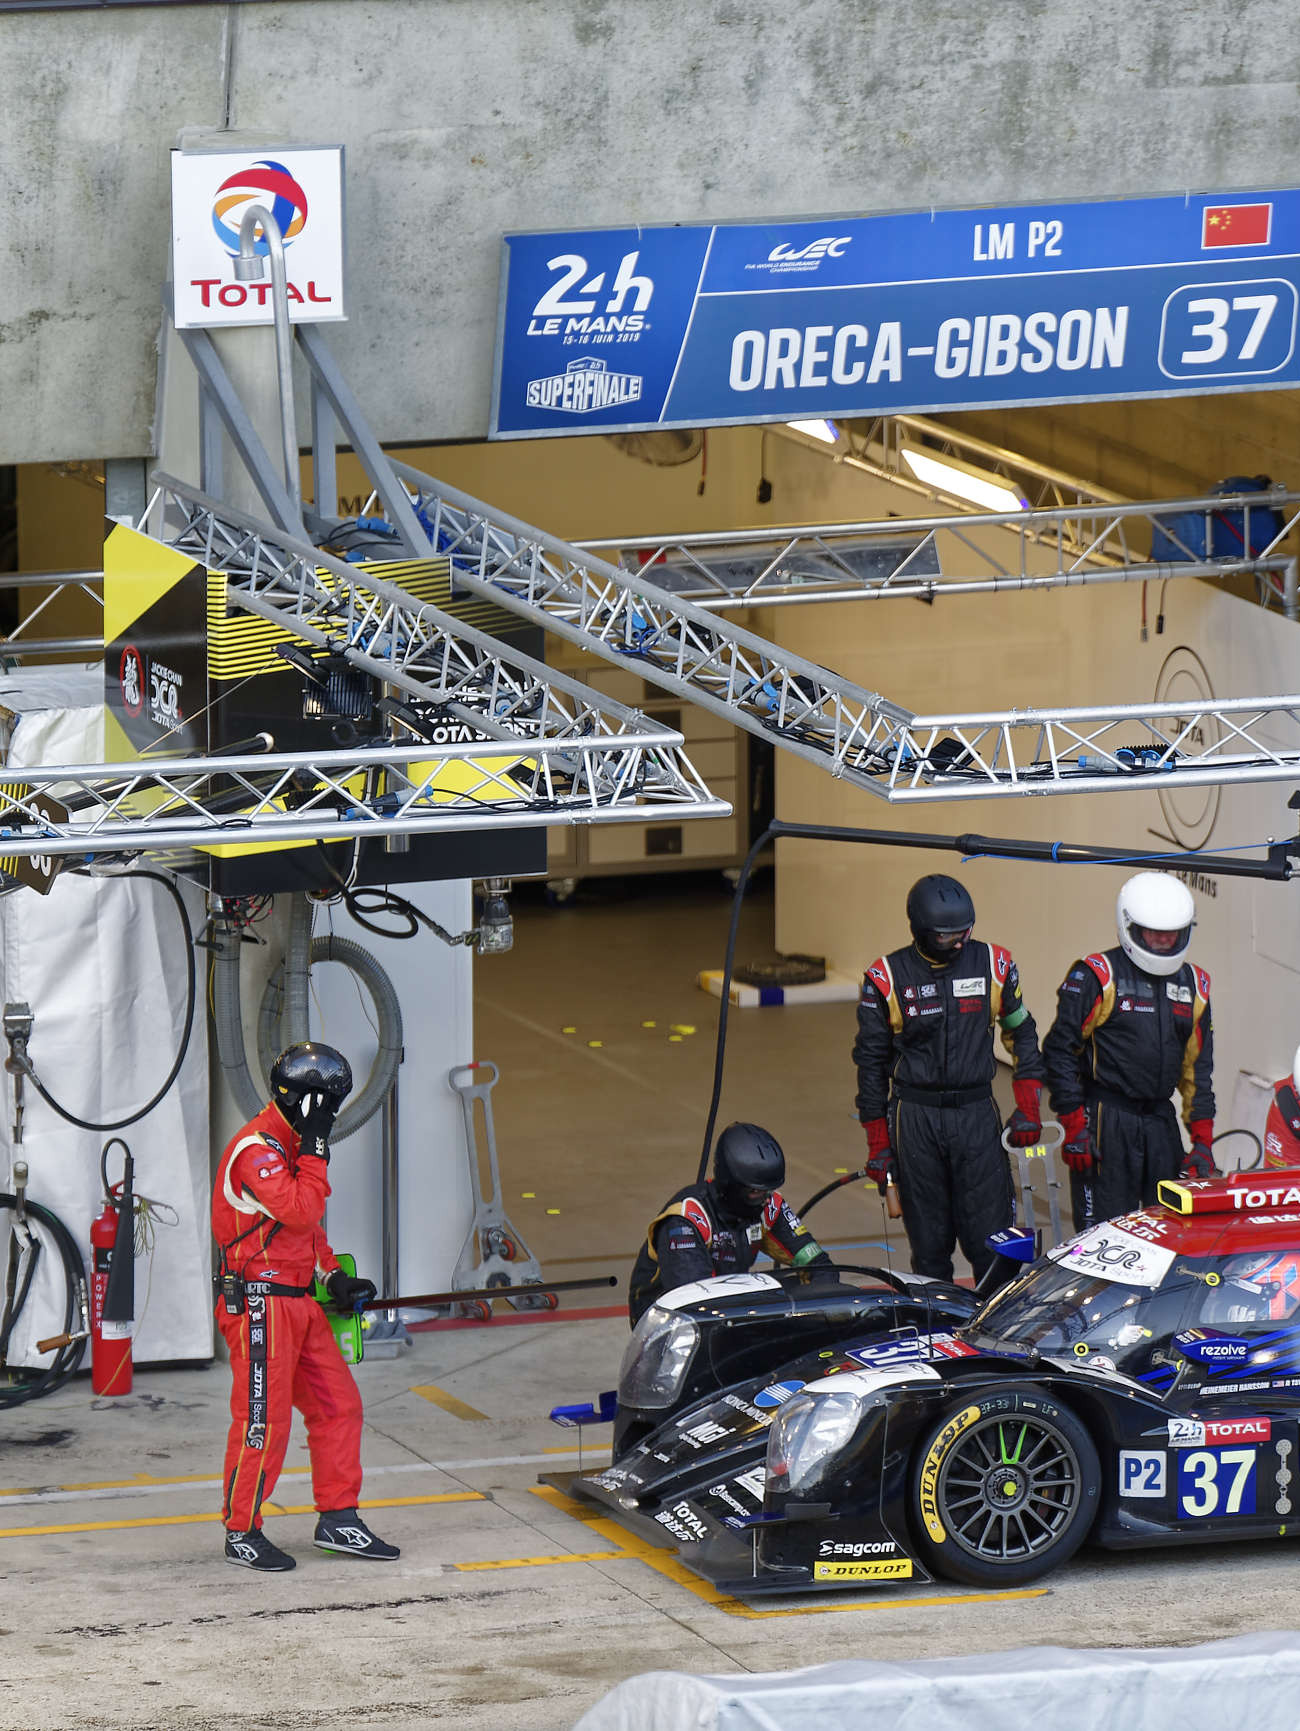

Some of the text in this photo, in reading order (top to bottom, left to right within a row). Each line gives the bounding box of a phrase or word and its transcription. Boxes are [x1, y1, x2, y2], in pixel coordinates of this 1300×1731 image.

[768, 237, 852, 261] WEC
[973, 219, 1063, 262] LM P2
[532, 249, 654, 316] 24h
[527, 314, 645, 336] LE MANS
[562, 332, 640, 345] 15-16 JUIN 2019
[1180, 294, 1279, 364] 37
[728, 306, 1129, 391] ORECA-GIBSON
[528, 371, 640, 410] SUPERFINALE
[1070, 1257, 1107, 1272] JOTA
[1200, 1344, 1247, 1355] rezolve
[254, 1362, 263, 1398] JOTA
[1207, 1422, 1268, 1436] TOTAL
[1124, 1457, 1161, 1490] P2
[1182, 1449, 1257, 1517] 37
[673, 1500, 708, 1538] TOTAL
[833, 1541, 896, 1557] sagcom
[833, 1564, 907, 1576] DUNLOP
